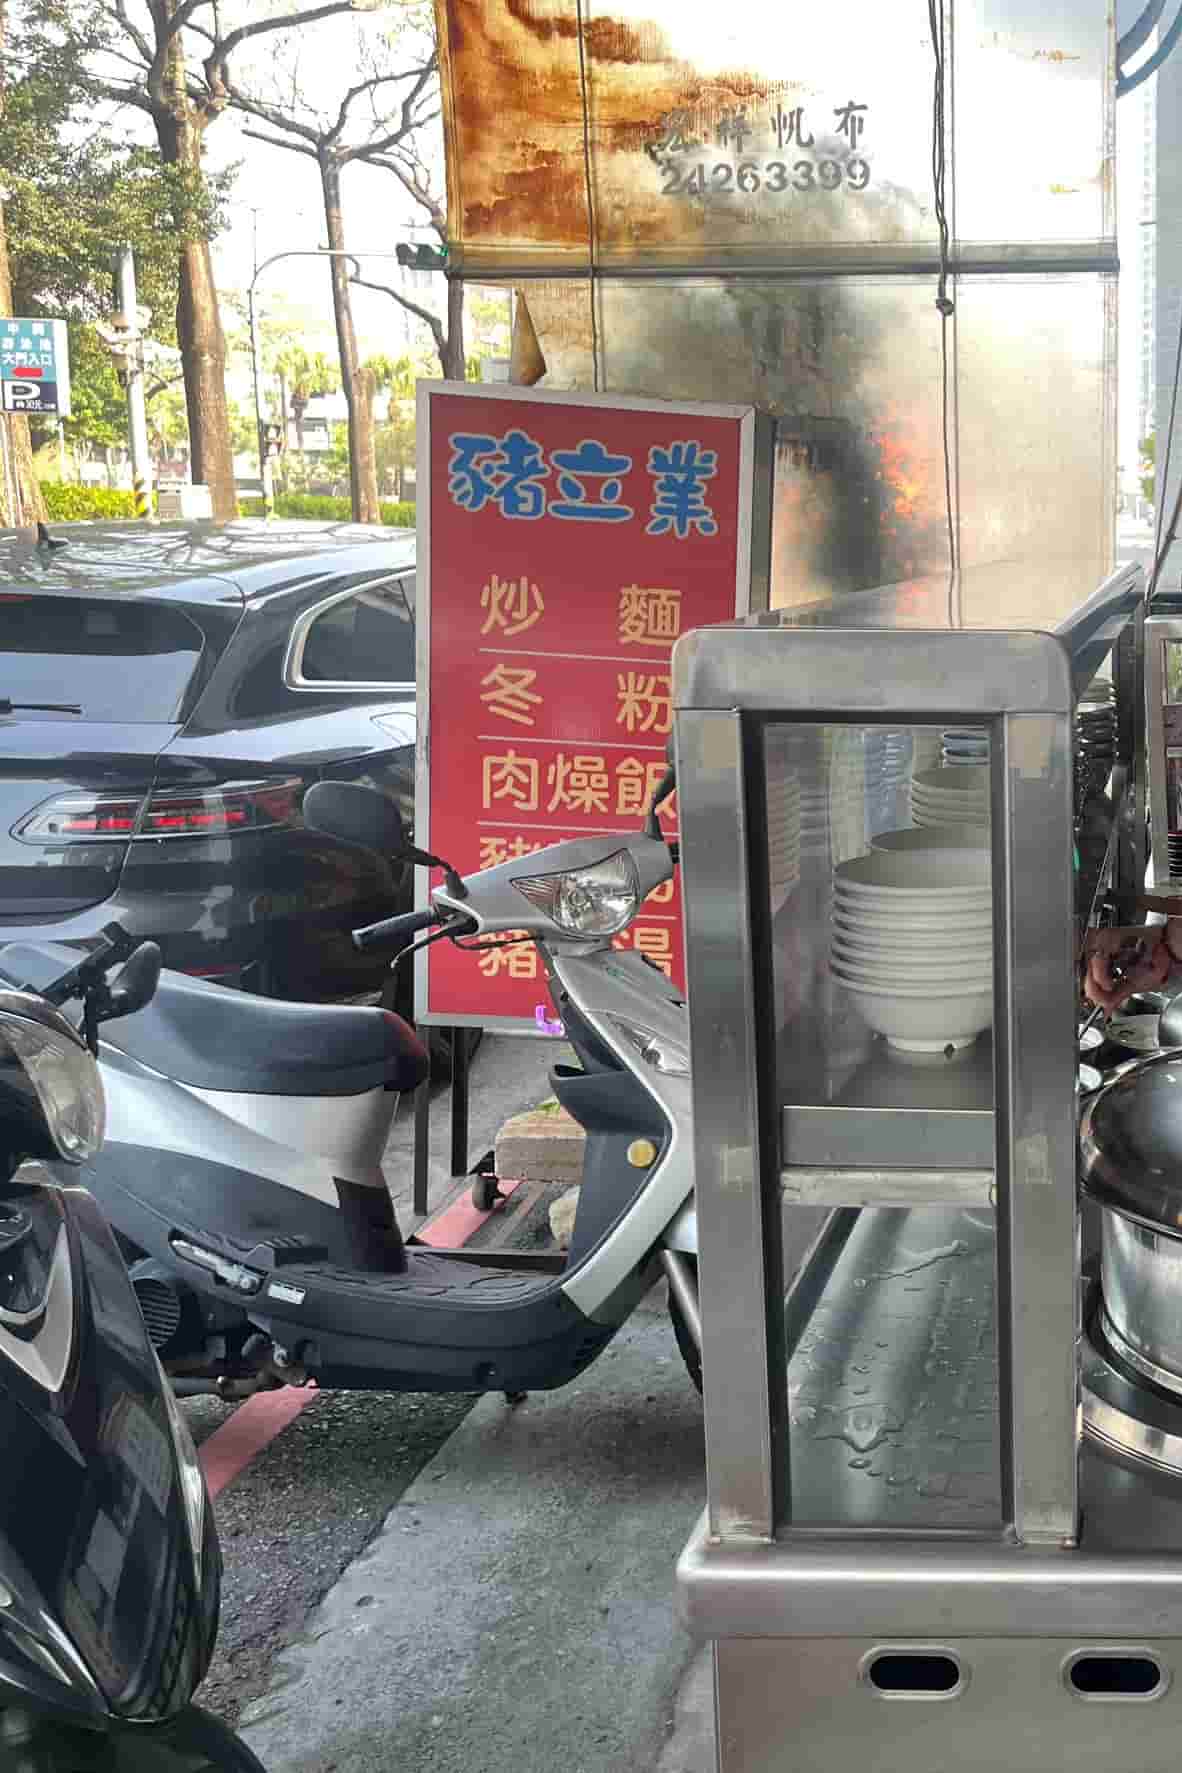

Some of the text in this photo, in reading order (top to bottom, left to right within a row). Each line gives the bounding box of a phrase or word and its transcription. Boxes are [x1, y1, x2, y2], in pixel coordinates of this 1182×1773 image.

[660, 159, 870, 195] 24263399
[448, 428, 718, 538] 豬立業
[480, 574, 682, 647] 炒麵
[480, 663, 673, 734] 冬粉
